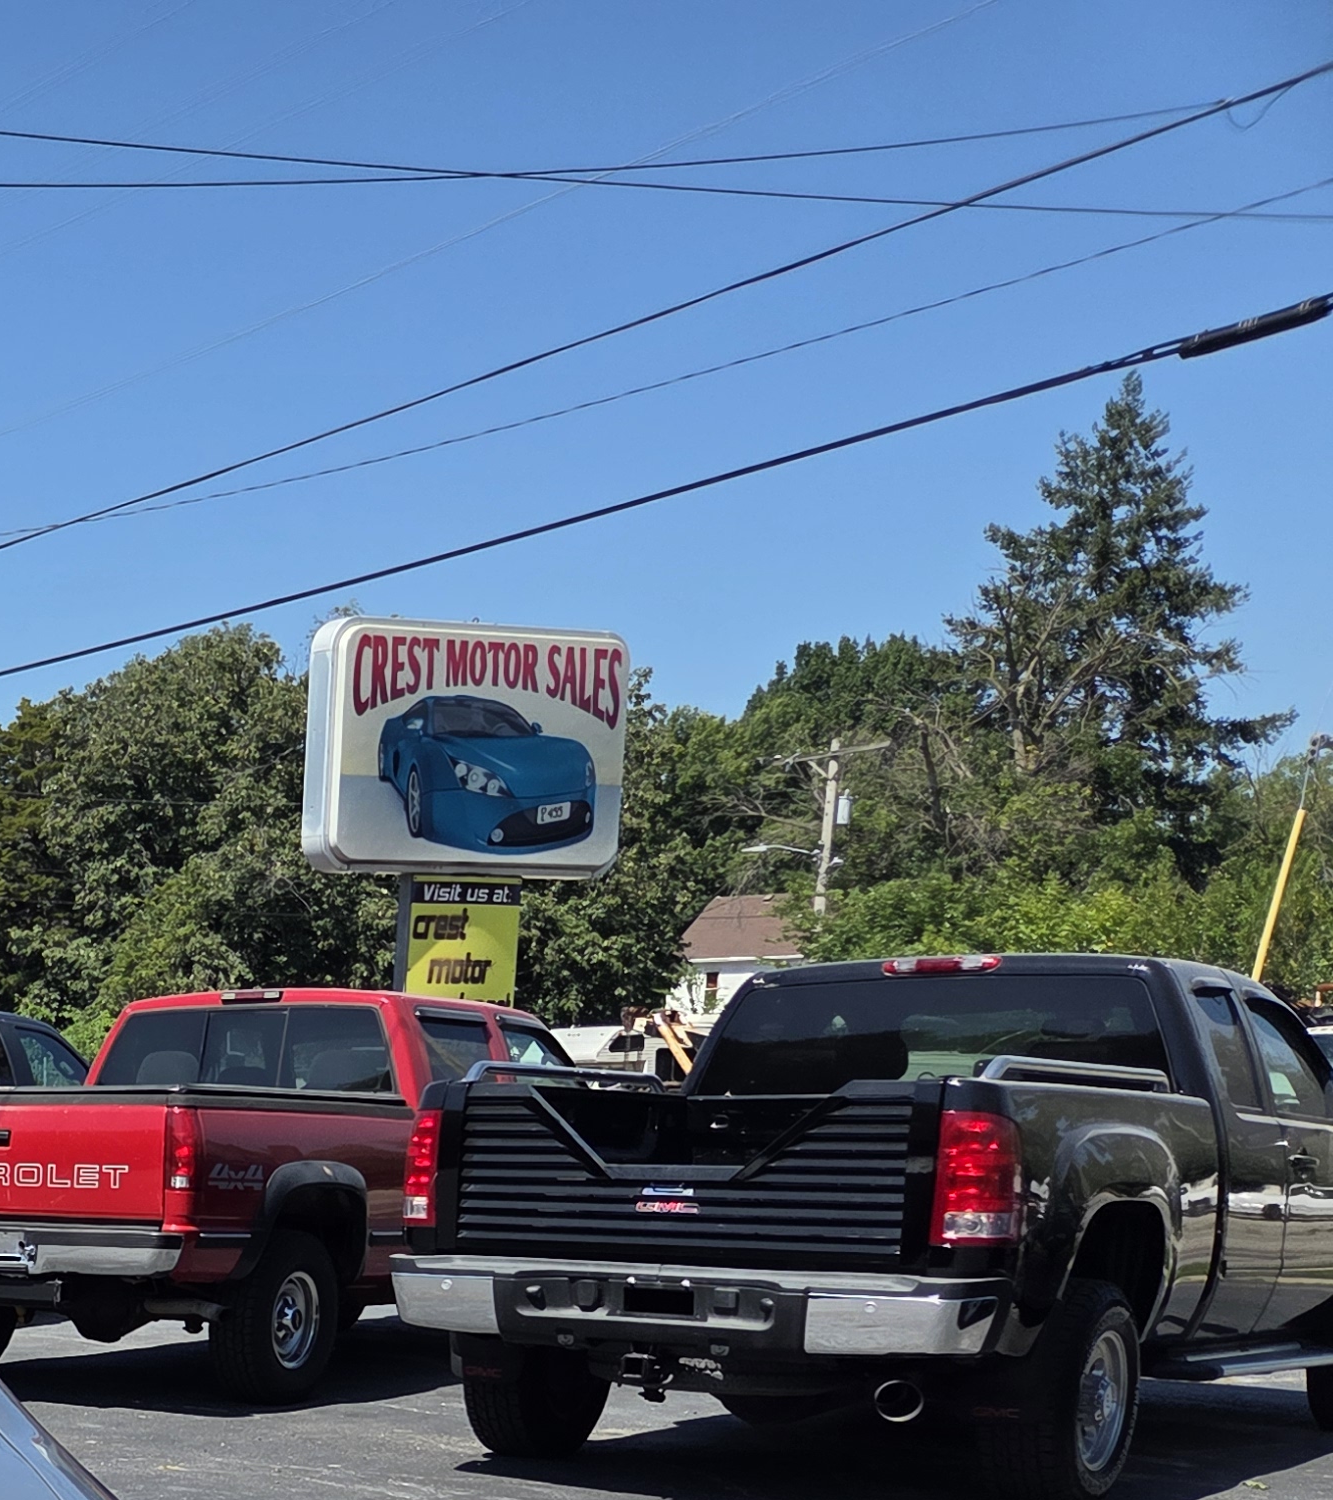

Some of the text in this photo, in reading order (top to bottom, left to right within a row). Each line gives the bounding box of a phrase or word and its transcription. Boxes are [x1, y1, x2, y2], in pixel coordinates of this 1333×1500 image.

[352, 633, 623, 730] CREST MOTOR SALES
[423, 884, 462, 902] Visit
[466, 887, 490, 902] us
[412, 907, 470, 941] crest
[427, 952, 493, 985] motor
[635, 1201, 700, 1214] GMC
